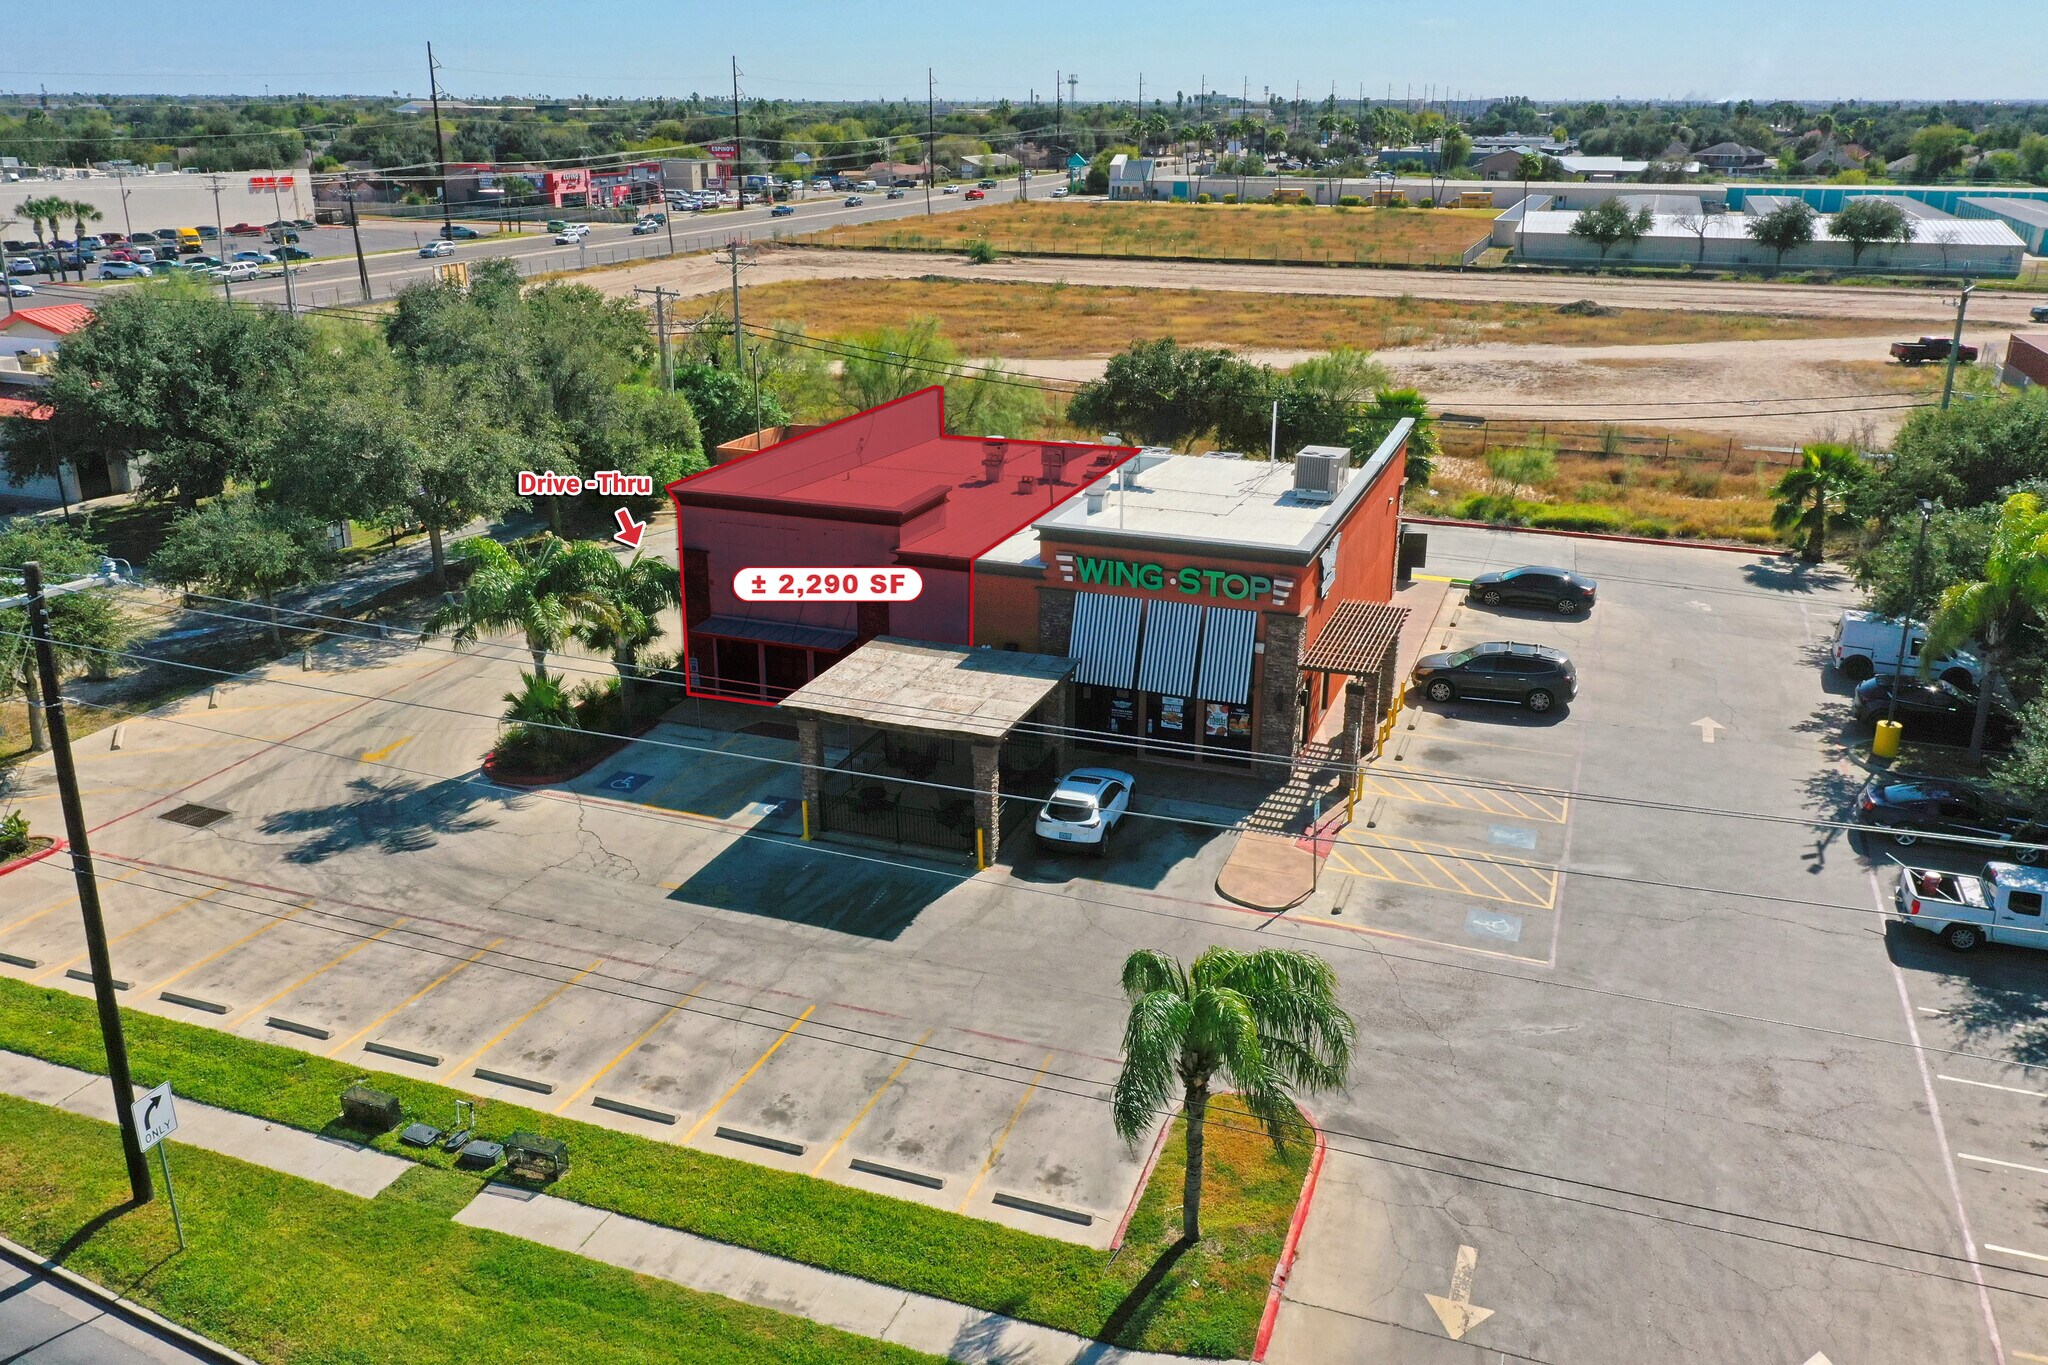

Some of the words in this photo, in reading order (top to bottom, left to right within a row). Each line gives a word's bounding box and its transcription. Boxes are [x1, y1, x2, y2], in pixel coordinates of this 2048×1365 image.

[1076, 556, 1164, 590] WING
[1178, 567, 1272, 601] STOP
[145, 1119, 171, 1143] ONLY
